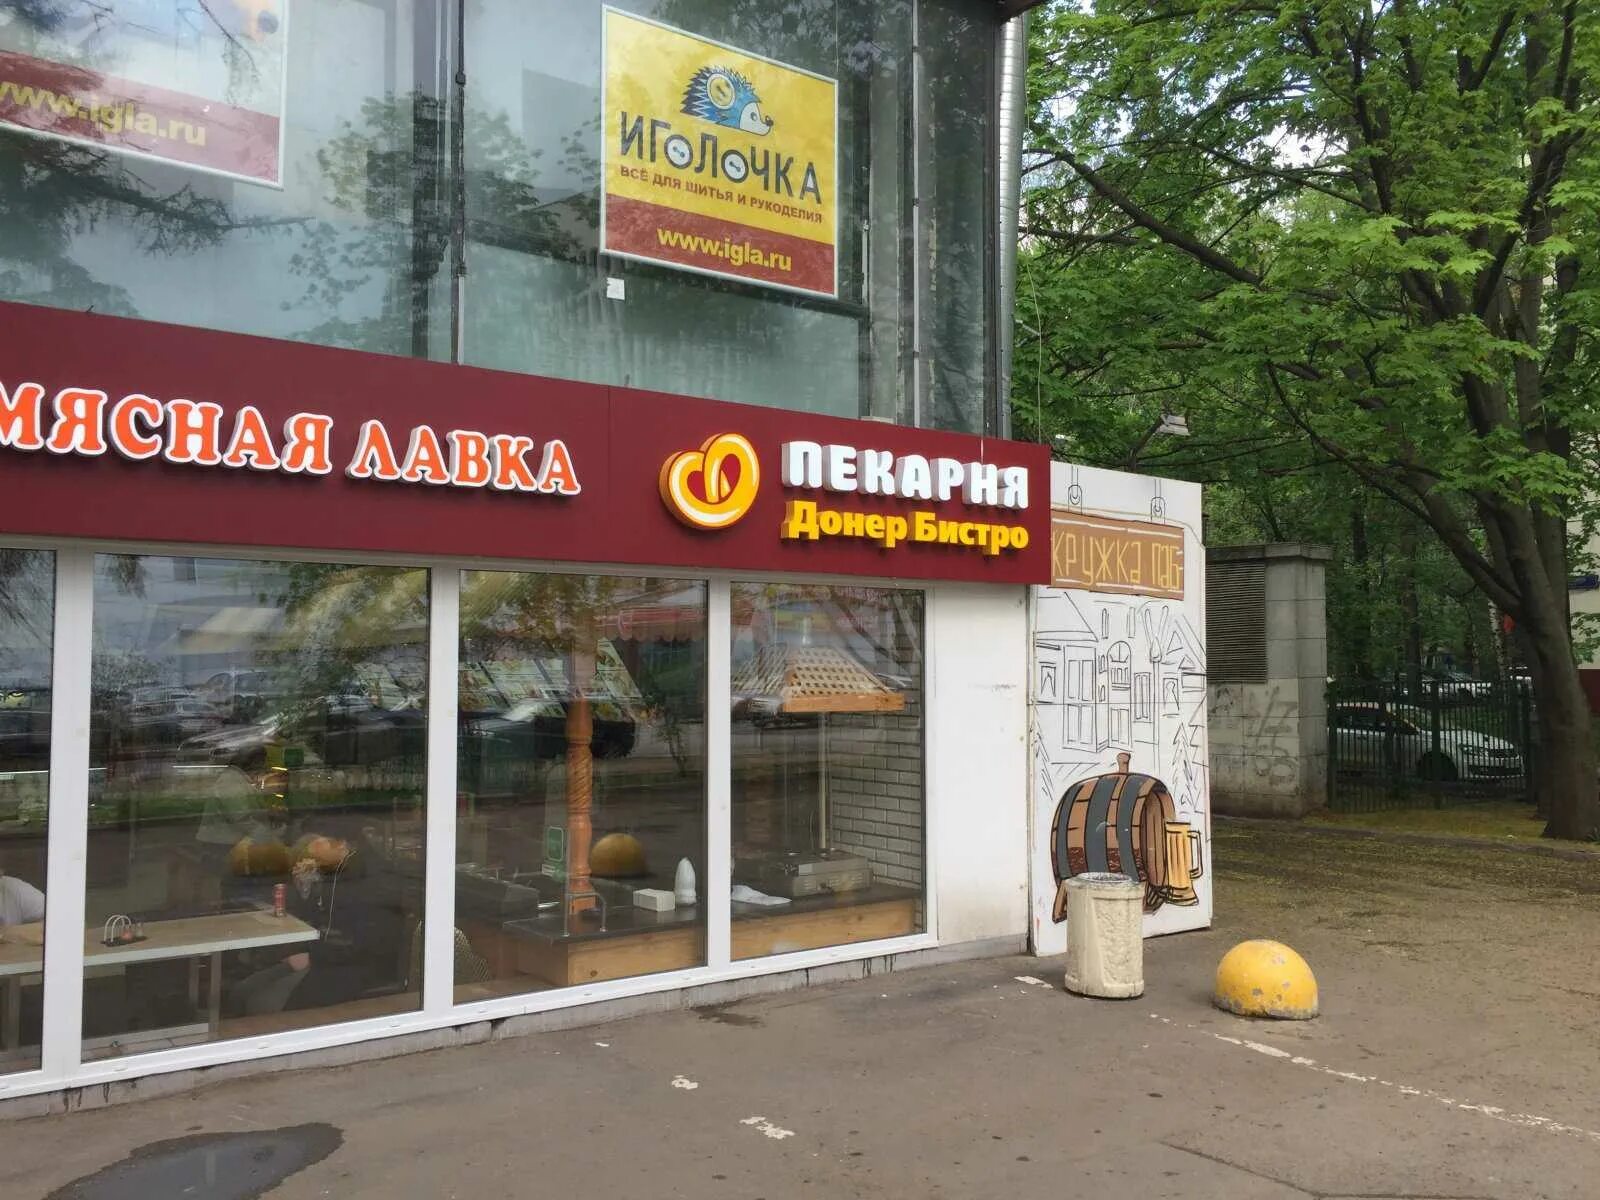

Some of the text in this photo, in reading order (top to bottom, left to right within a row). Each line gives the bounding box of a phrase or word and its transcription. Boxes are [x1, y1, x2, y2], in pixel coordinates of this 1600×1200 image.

[0, 81, 206, 146] ww.igla.ru
[620, 165, 822, 224] ВСЁ ДЛЯ ШИТЬЯ И РУКОДЕЛИЯ
[656, 228, 792, 271] www.igla.ru
[0, 382, 581, 495] МЯСНАЯ ЛАВКА
[781, 440, 1029, 509] ПЕКАРНЯ
[781, 500, 1029, 556] Донер Бистро
